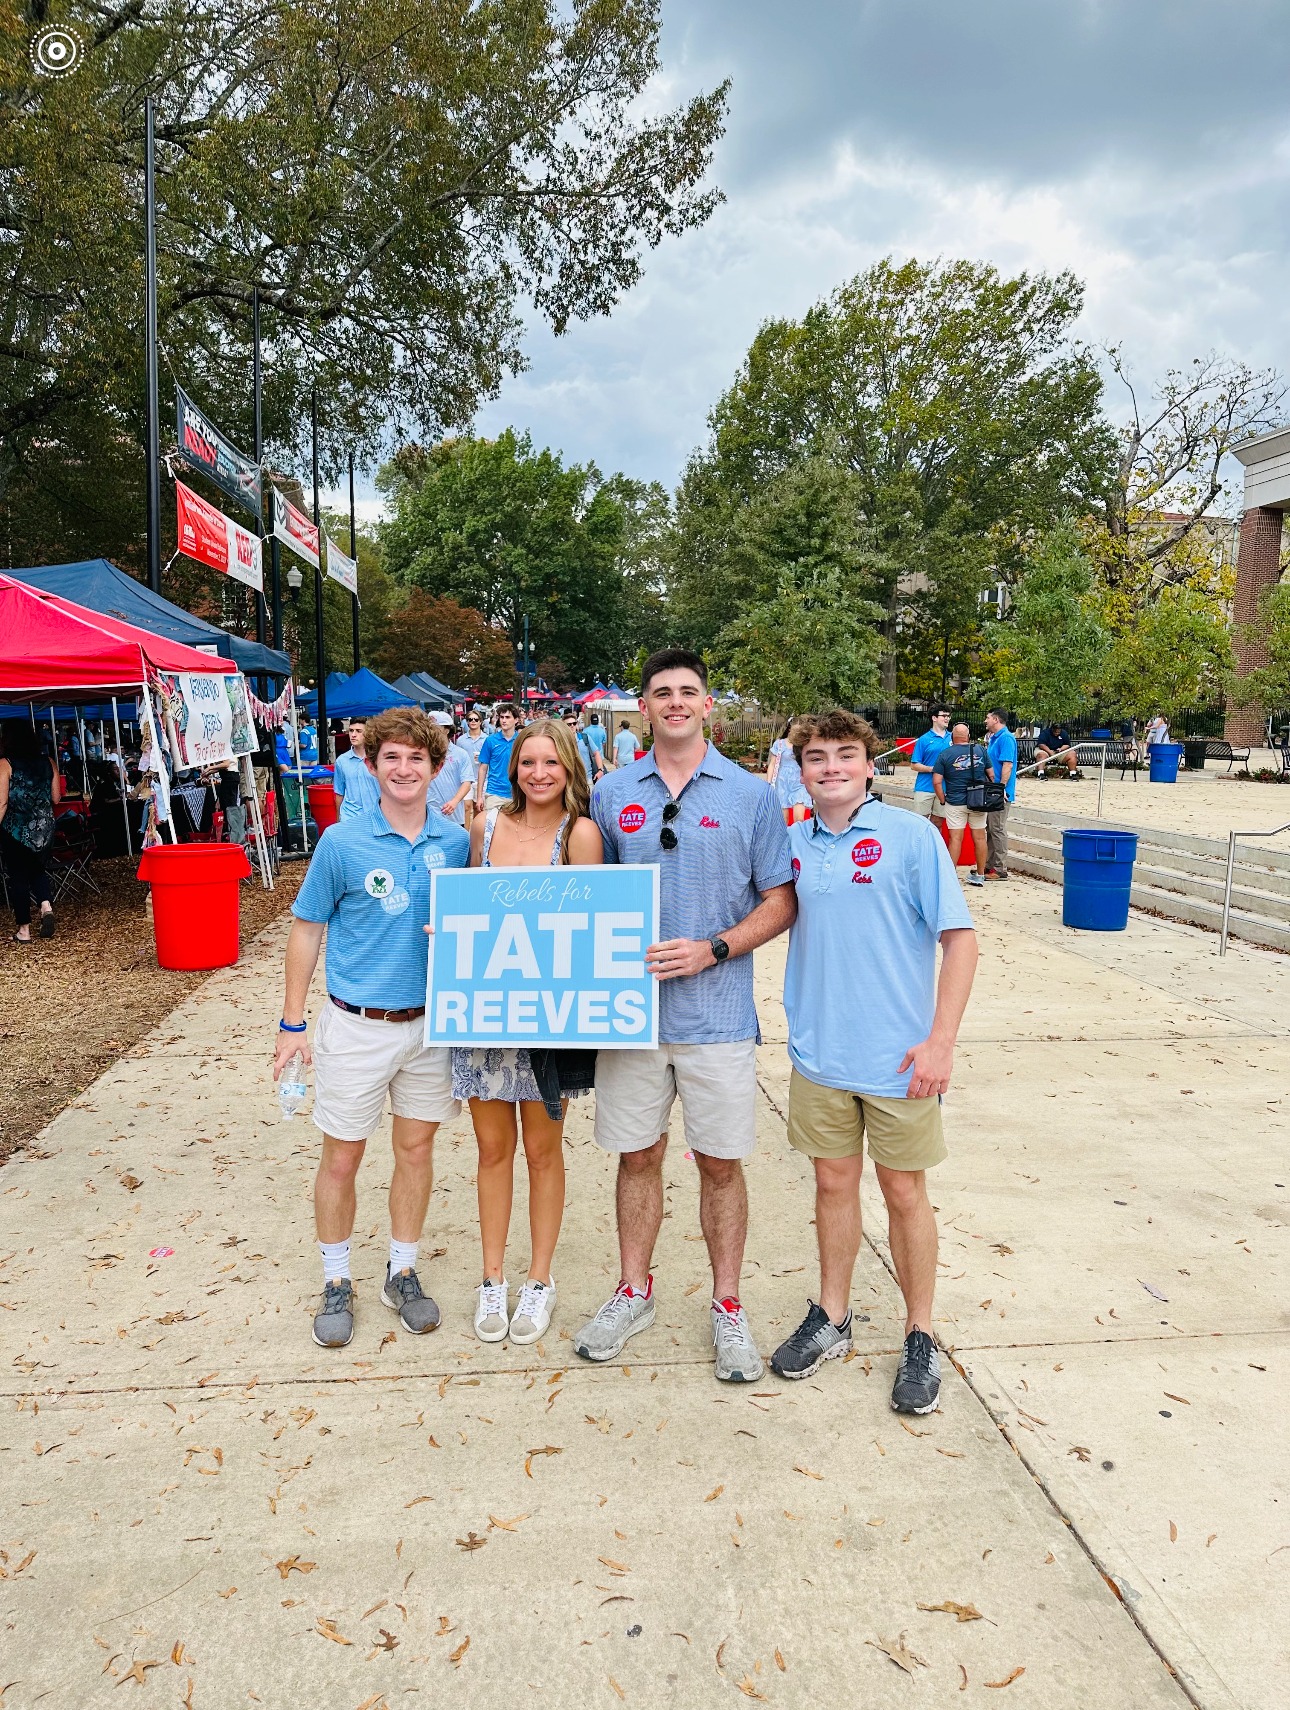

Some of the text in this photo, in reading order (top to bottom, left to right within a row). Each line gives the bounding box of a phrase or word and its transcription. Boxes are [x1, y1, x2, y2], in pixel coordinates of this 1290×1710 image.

[620, 812, 645, 822] TATE
[853, 845, 881, 857] TATE
[423, 852, 445, 864] TATE
[854, 854, 879, 863] REEVES
[382, 893, 408, 906] TATE
[488, 877, 594, 912] Rebels for
[442, 911, 645, 979] TATE
[435, 989, 647, 1035] REEVES
